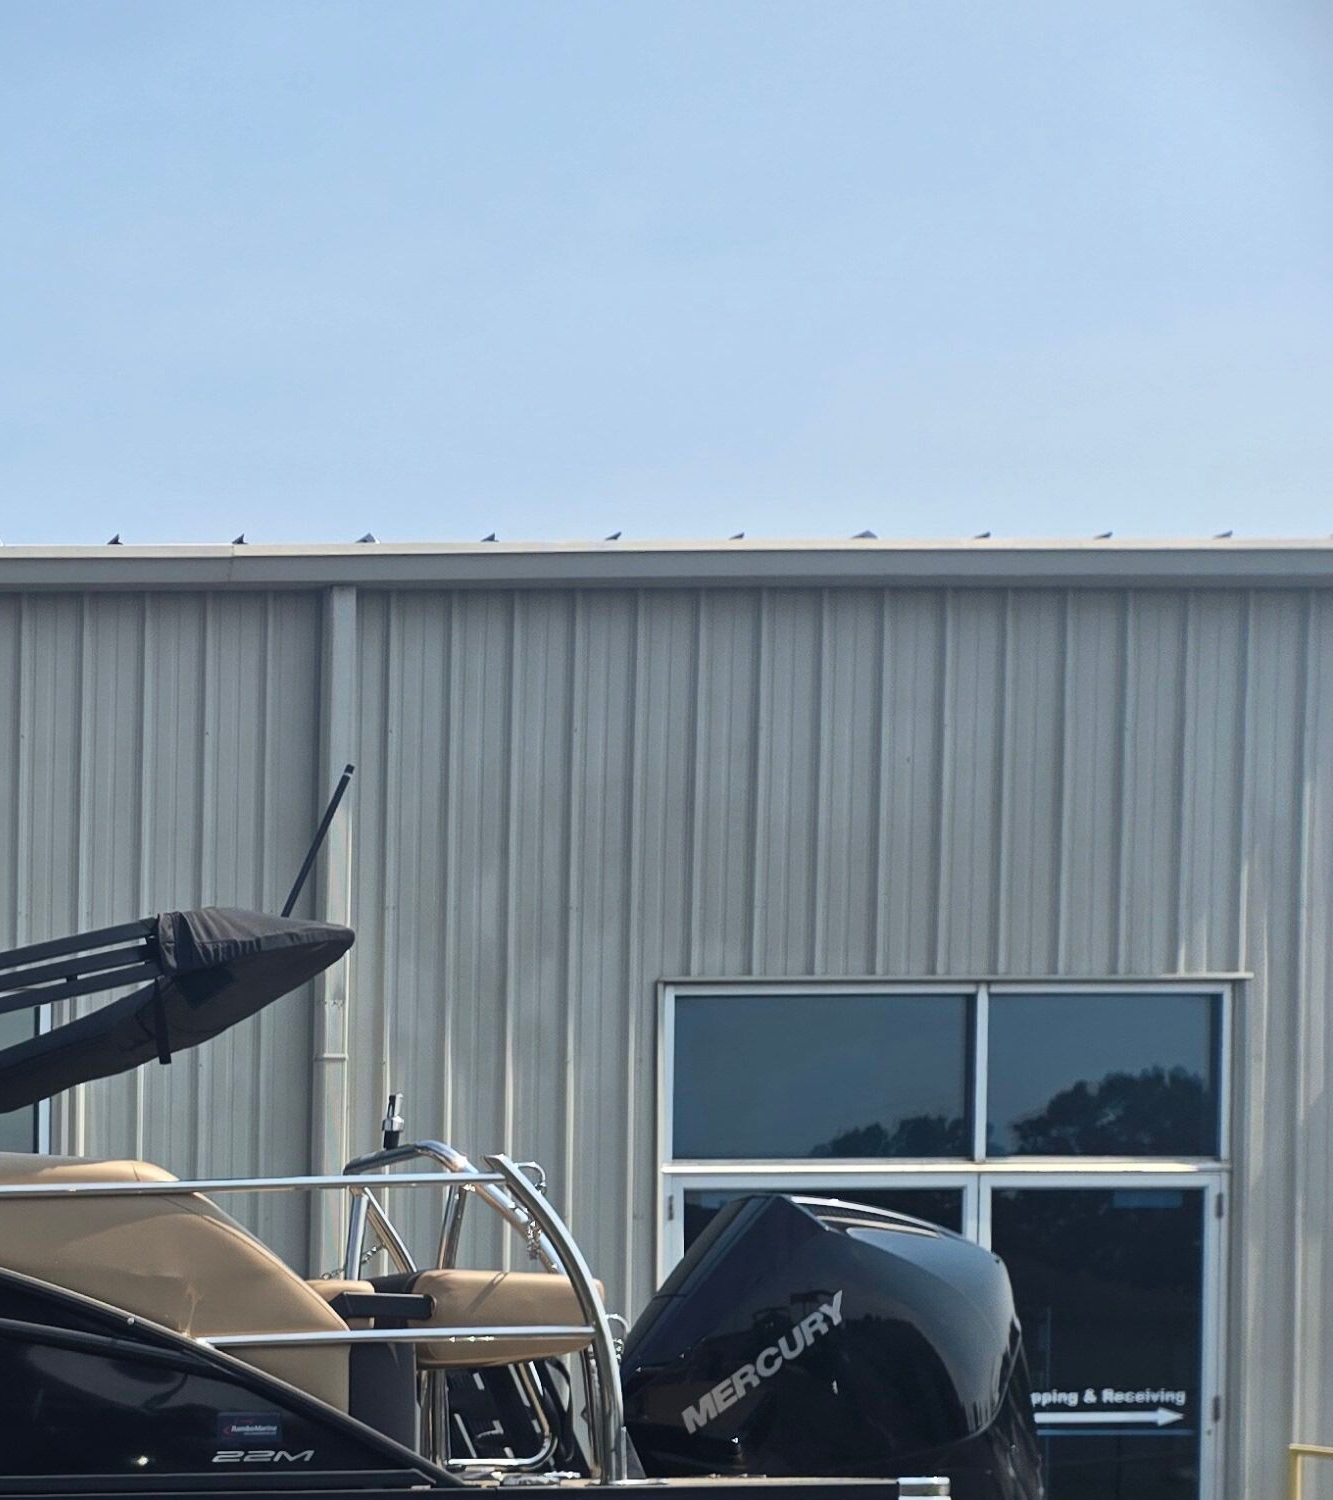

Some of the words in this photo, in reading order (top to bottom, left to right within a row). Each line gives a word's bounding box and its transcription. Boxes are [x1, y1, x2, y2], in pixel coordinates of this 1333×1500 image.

[681, 1289, 843, 1435] MERCURY
[1030, 1389, 1079, 1407] pping
[1083, 1388, 1097, 1404] &
[1101, 1388, 1186, 1407] Receiving
[212, 1450, 315, 1462] 22M
